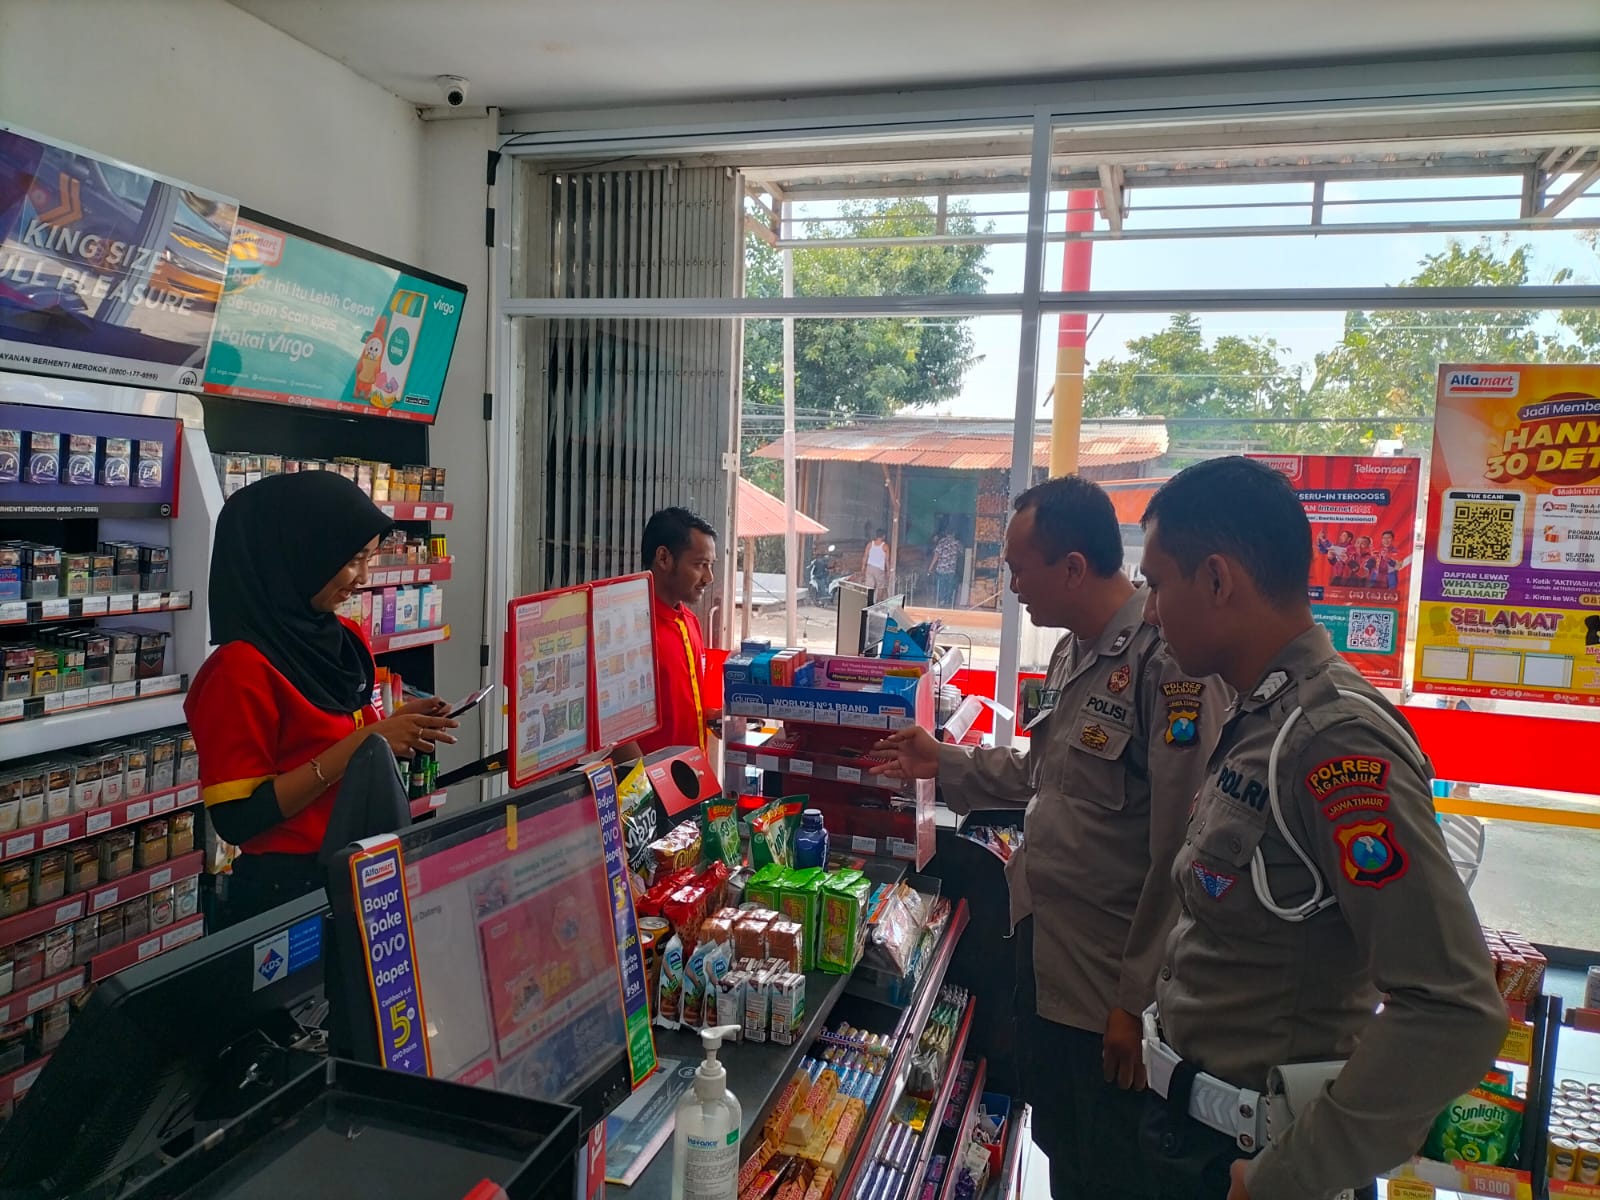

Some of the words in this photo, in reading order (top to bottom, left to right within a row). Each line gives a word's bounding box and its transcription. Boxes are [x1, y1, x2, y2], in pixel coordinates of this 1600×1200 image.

[23, 219, 99, 259] KING
[106, 241, 164, 275] SIZE
[56, 267, 198, 316] PLEASURE
[226, 294, 278, 320] dengan
[280, 306, 310, 325] Scan
[310, 287, 341, 308] Lebih
[342, 296, 376, 319] Cepat
[219, 325, 266, 351] Pakai
[33, 357, 70, 369] BERHENTI
[72, 362, 108, 374] MEROKOK
[1450, 374, 1514, 386] Alfamart
[1522, 404, 1550, 418] Jadi
[1353, 463, 1407, 474] Telkomsel
[1484, 452, 1529, 481] 30
[1298, 492, 1336, 501] SERU-IN
[1557, 488, 1580, 496] Makin
[1442, 579, 1509, 590] WHATSAPP
[1443, 571, 1478, 579] DAFTAR
[1479, 573, 1510, 581] LEWAT
[1443, 588, 1507, 599] ALFAMART
[1450, 607, 1565, 632] SELAMAT
[1456, 626, 1492, 635] Member
[1162, 681, 1202, 692] POLRES
[772, 697, 815, 710] WORLD'S
[835, 702, 869, 714] BRAND
[1086, 696, 1128, 722] POLISI
[1310, 759, 1382, 787] POLRES
[1216, 765, 1270, 812] POLRI
[1315, 773, 1378, 795] NGANJUK
[596, 792, 616, 809] Bayar
[600, 810, 617, 830] pake
[602, 826, 619, 846] OVO
[364, 862, 394, 879] Alfamart
[363, 889, 399, 914] Bayar
[369, 911, 402, 942] pake
[371, 933, 406, 962] OVO
[375, 959, 411, 988] dapet
[381, 989, 405, 1008] Cashback
[626, 980, 640, 998] PSM
[389, 999, 412, 1049] 5
[1450, 1104, 1506, 1124] Sunlight
[1474, 1177, 1511, 1195] 15.000
